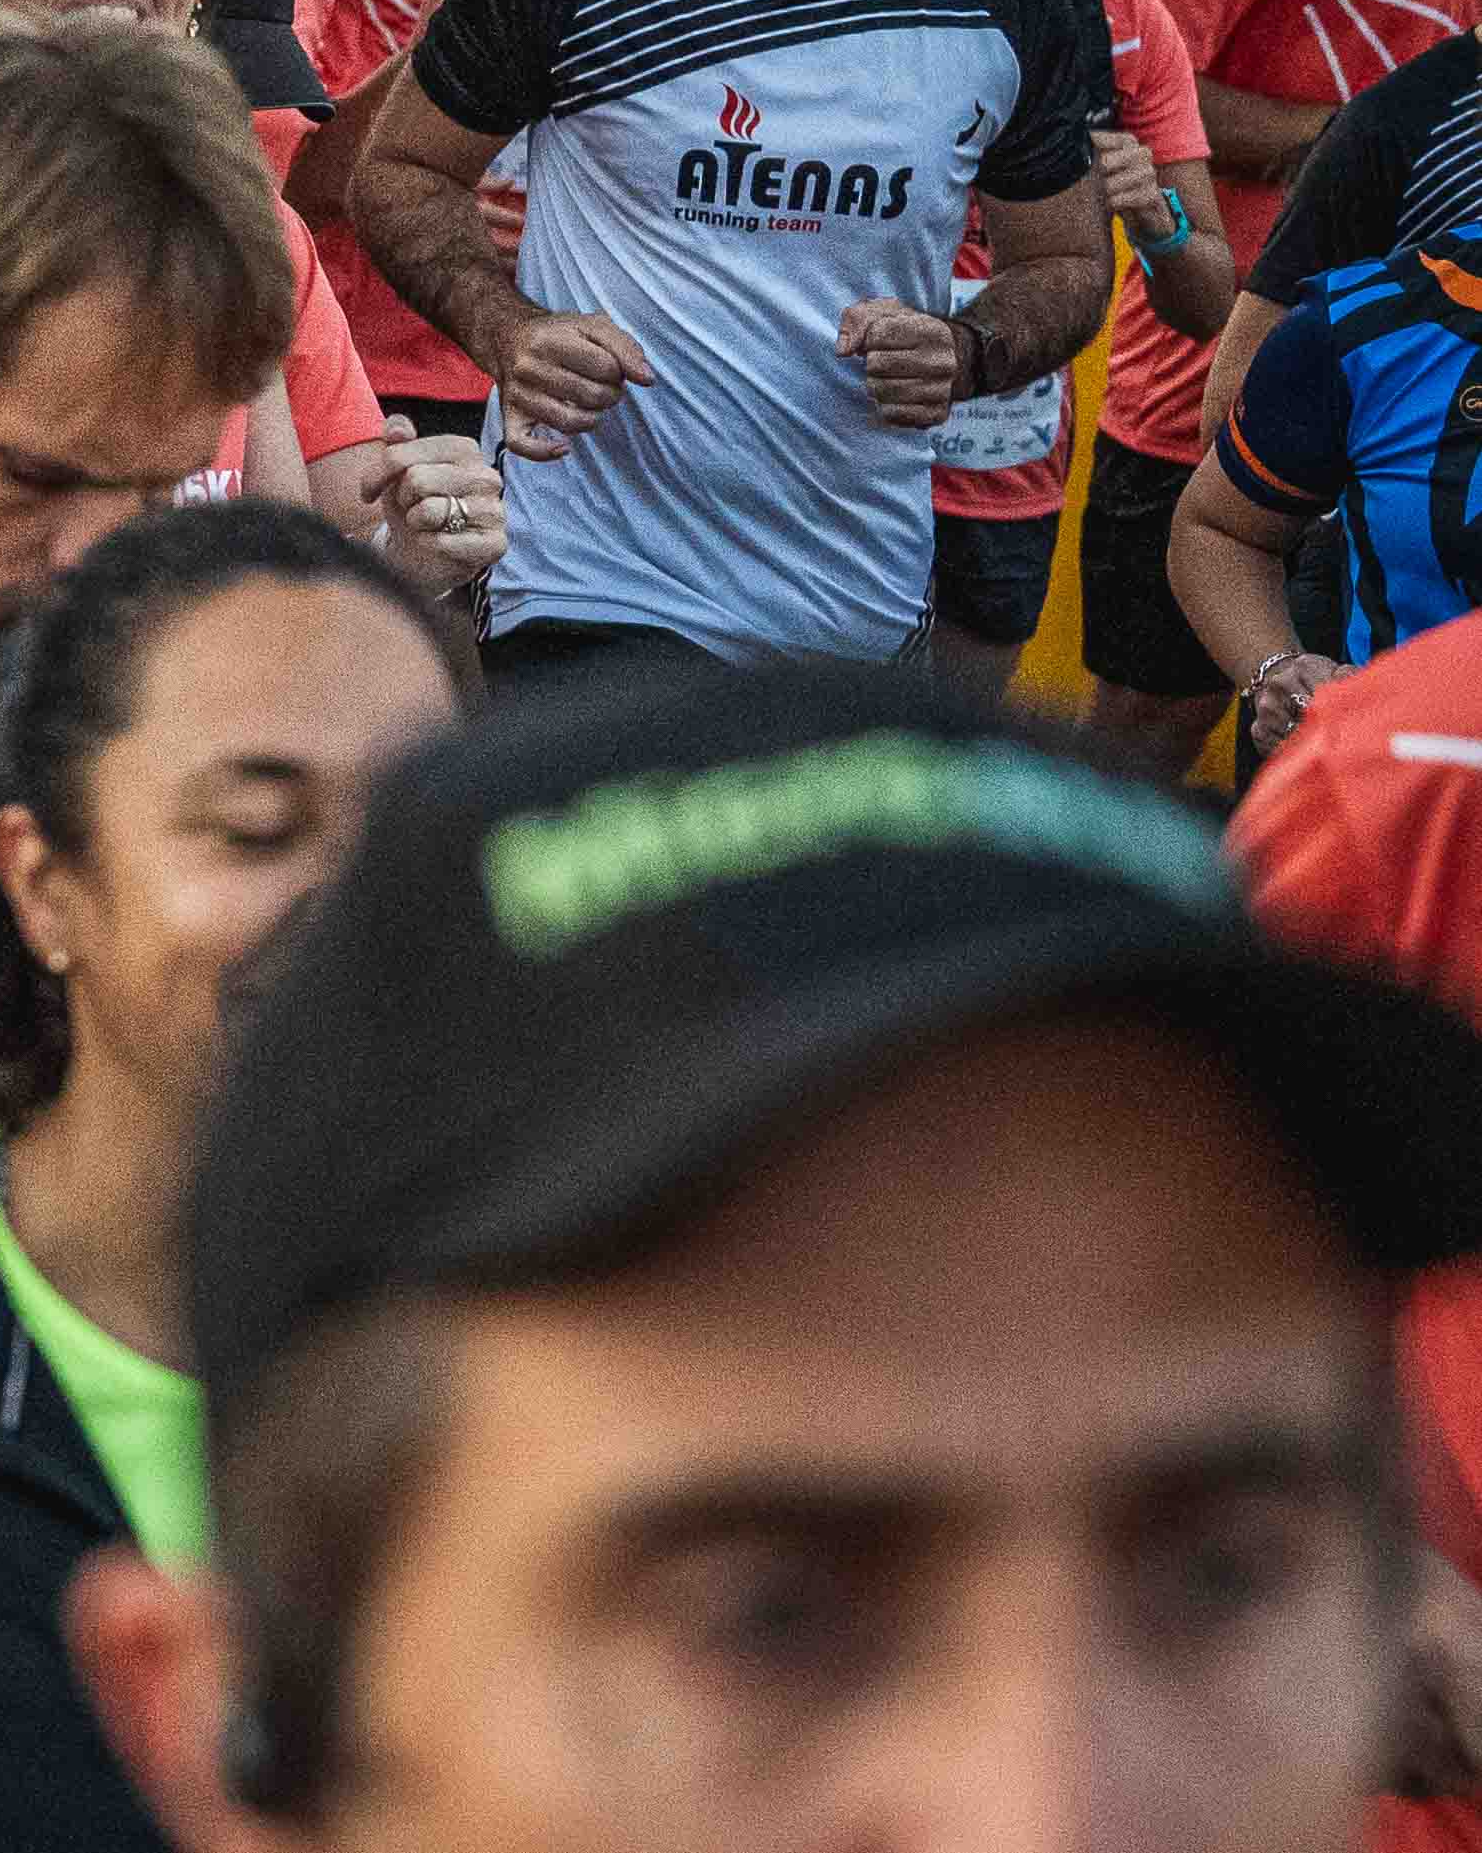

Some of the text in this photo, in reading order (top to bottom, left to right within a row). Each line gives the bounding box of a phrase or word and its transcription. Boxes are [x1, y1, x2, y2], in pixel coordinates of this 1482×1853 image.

[676, 139, 914, 220] ATENAS
[674, 206, 822, 234] running team
